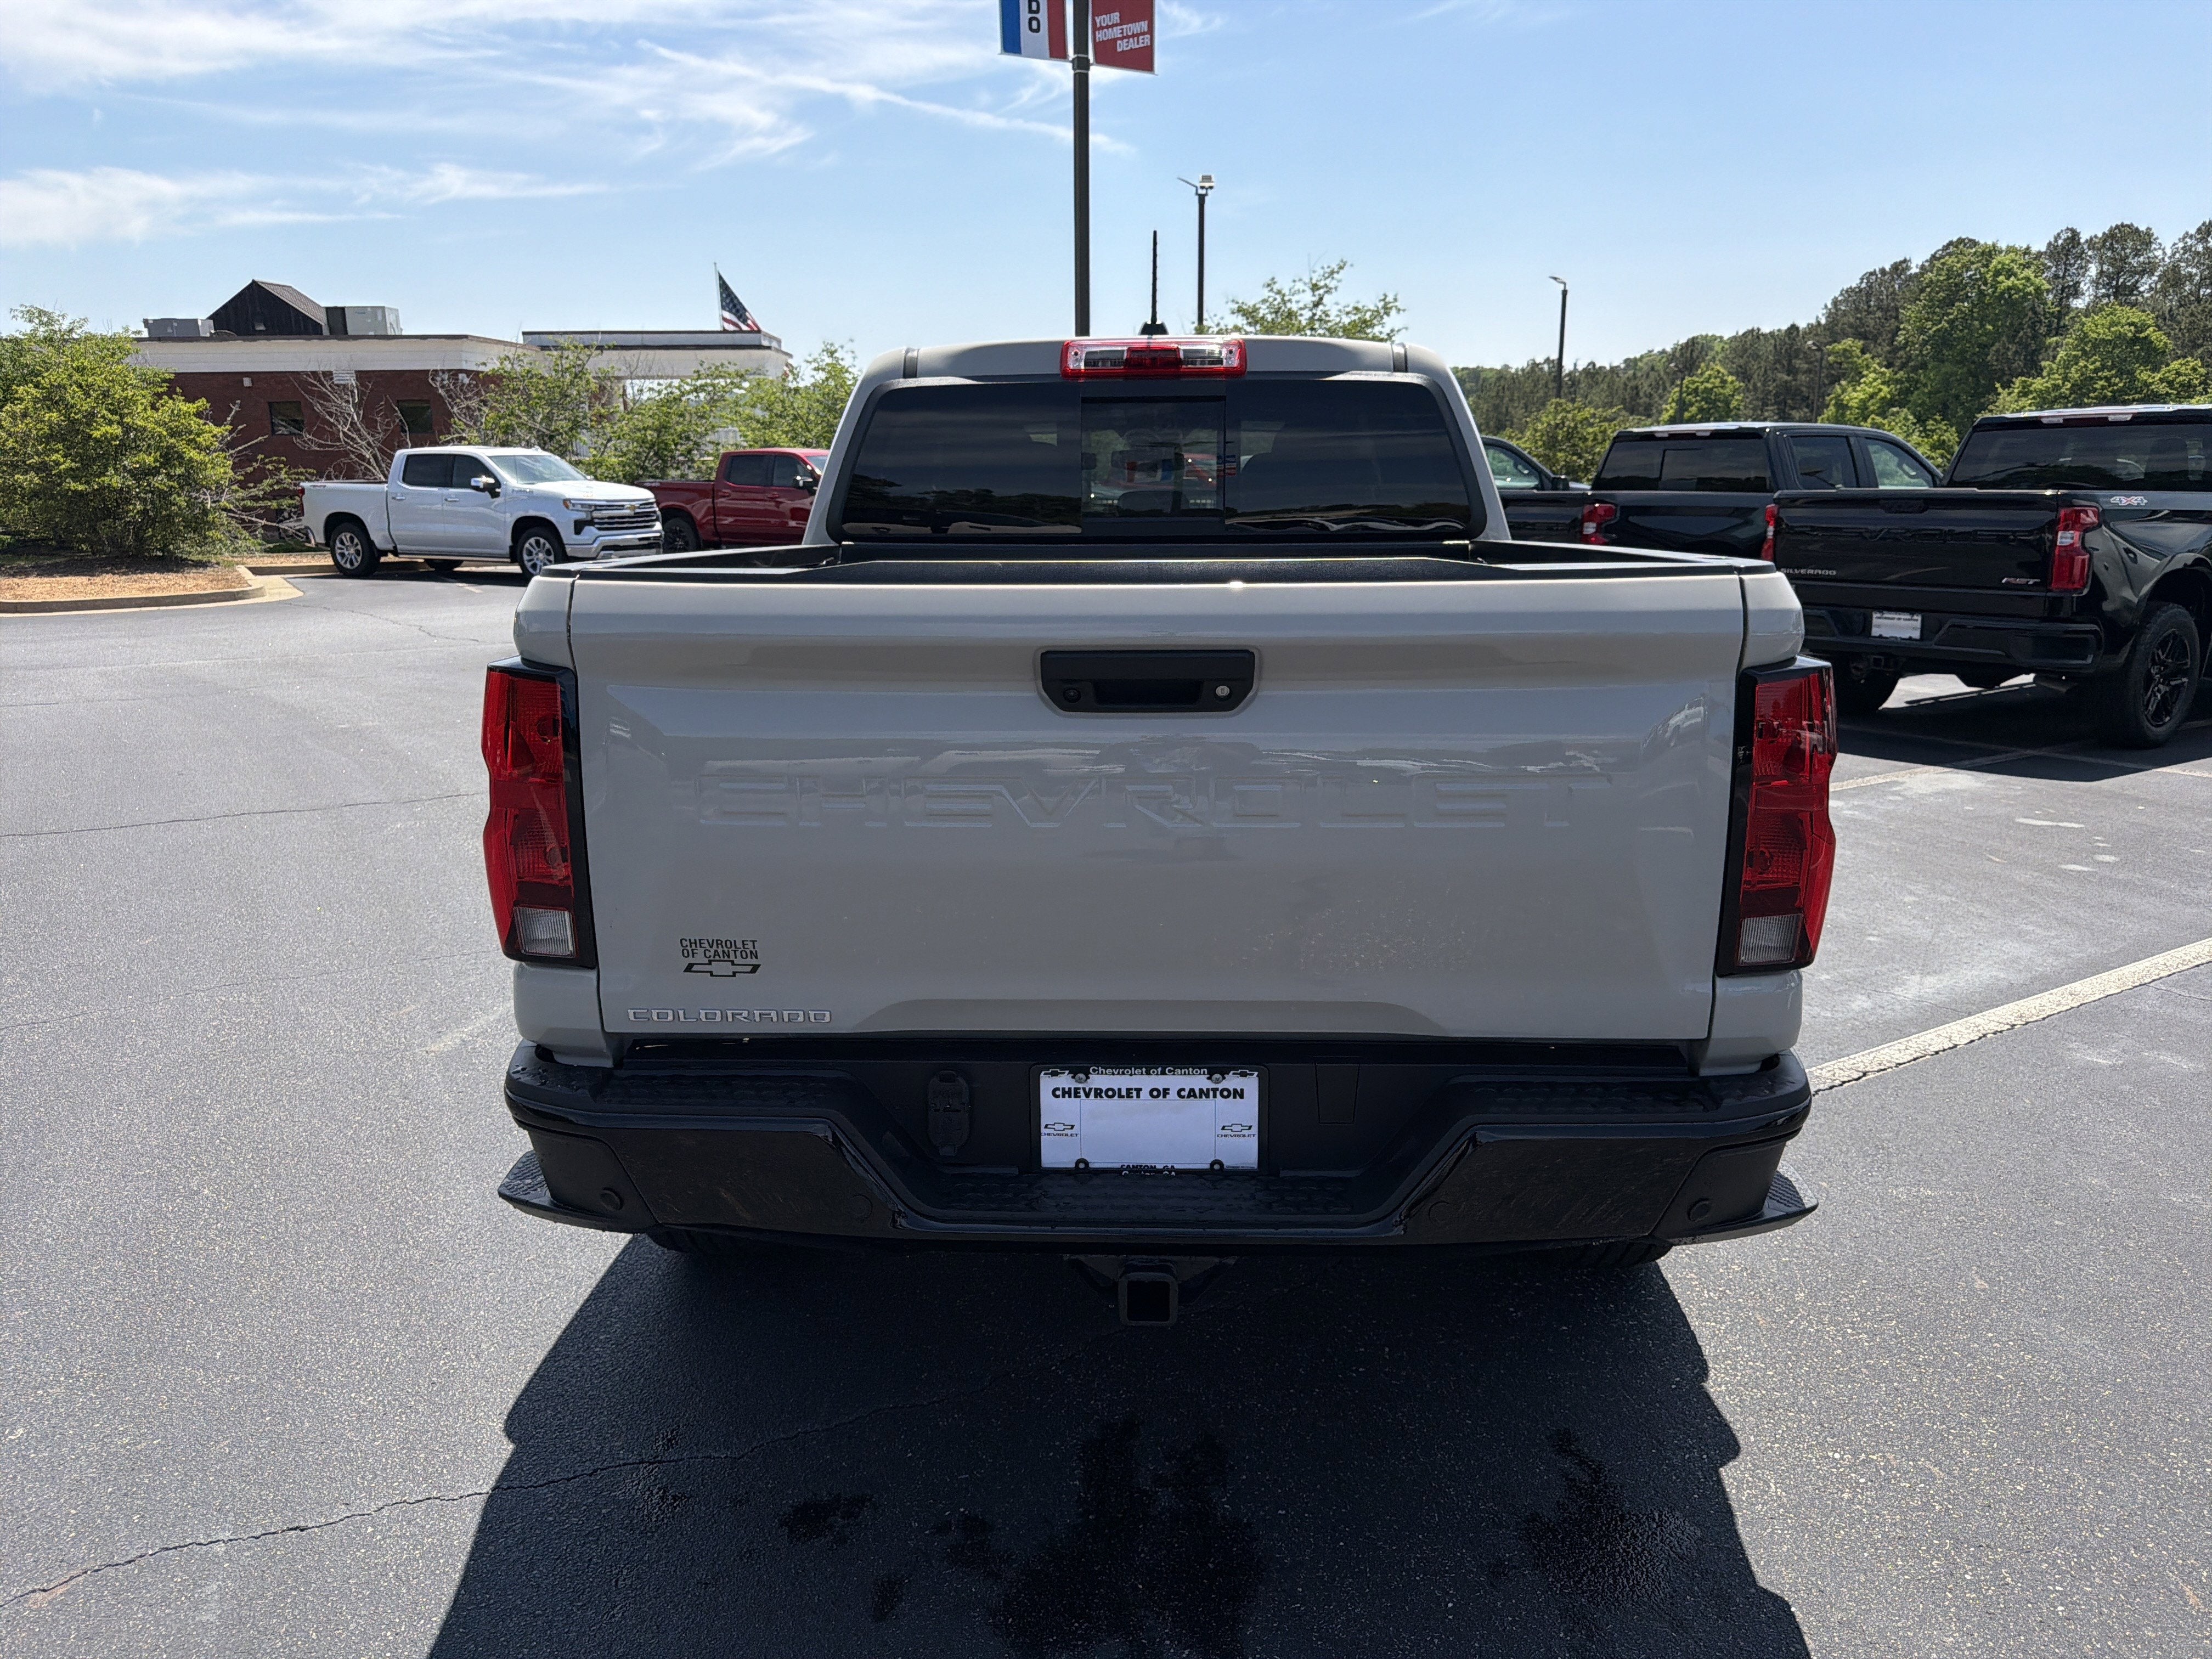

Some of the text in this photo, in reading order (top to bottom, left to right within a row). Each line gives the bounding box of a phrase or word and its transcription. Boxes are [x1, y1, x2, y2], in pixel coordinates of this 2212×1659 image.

[1095, 12, 1120, 27] YOUR
[1096, 20, 1148, 42] HOMETOWN
[1116, 35, 1150, 52] DEALER
[697, 772, 1612, 827] CHEVROLET
[680, 938, 758, 950] CHEVROLET
[681, 948, 758, 960] OF CANTON
[628, 1008, 832, 1023] COLORADO
[1090, 1066, 1146, 1075] Chevrolet
[1051, 1087, 1244, 1099] CHEVROLET OF CANTON
